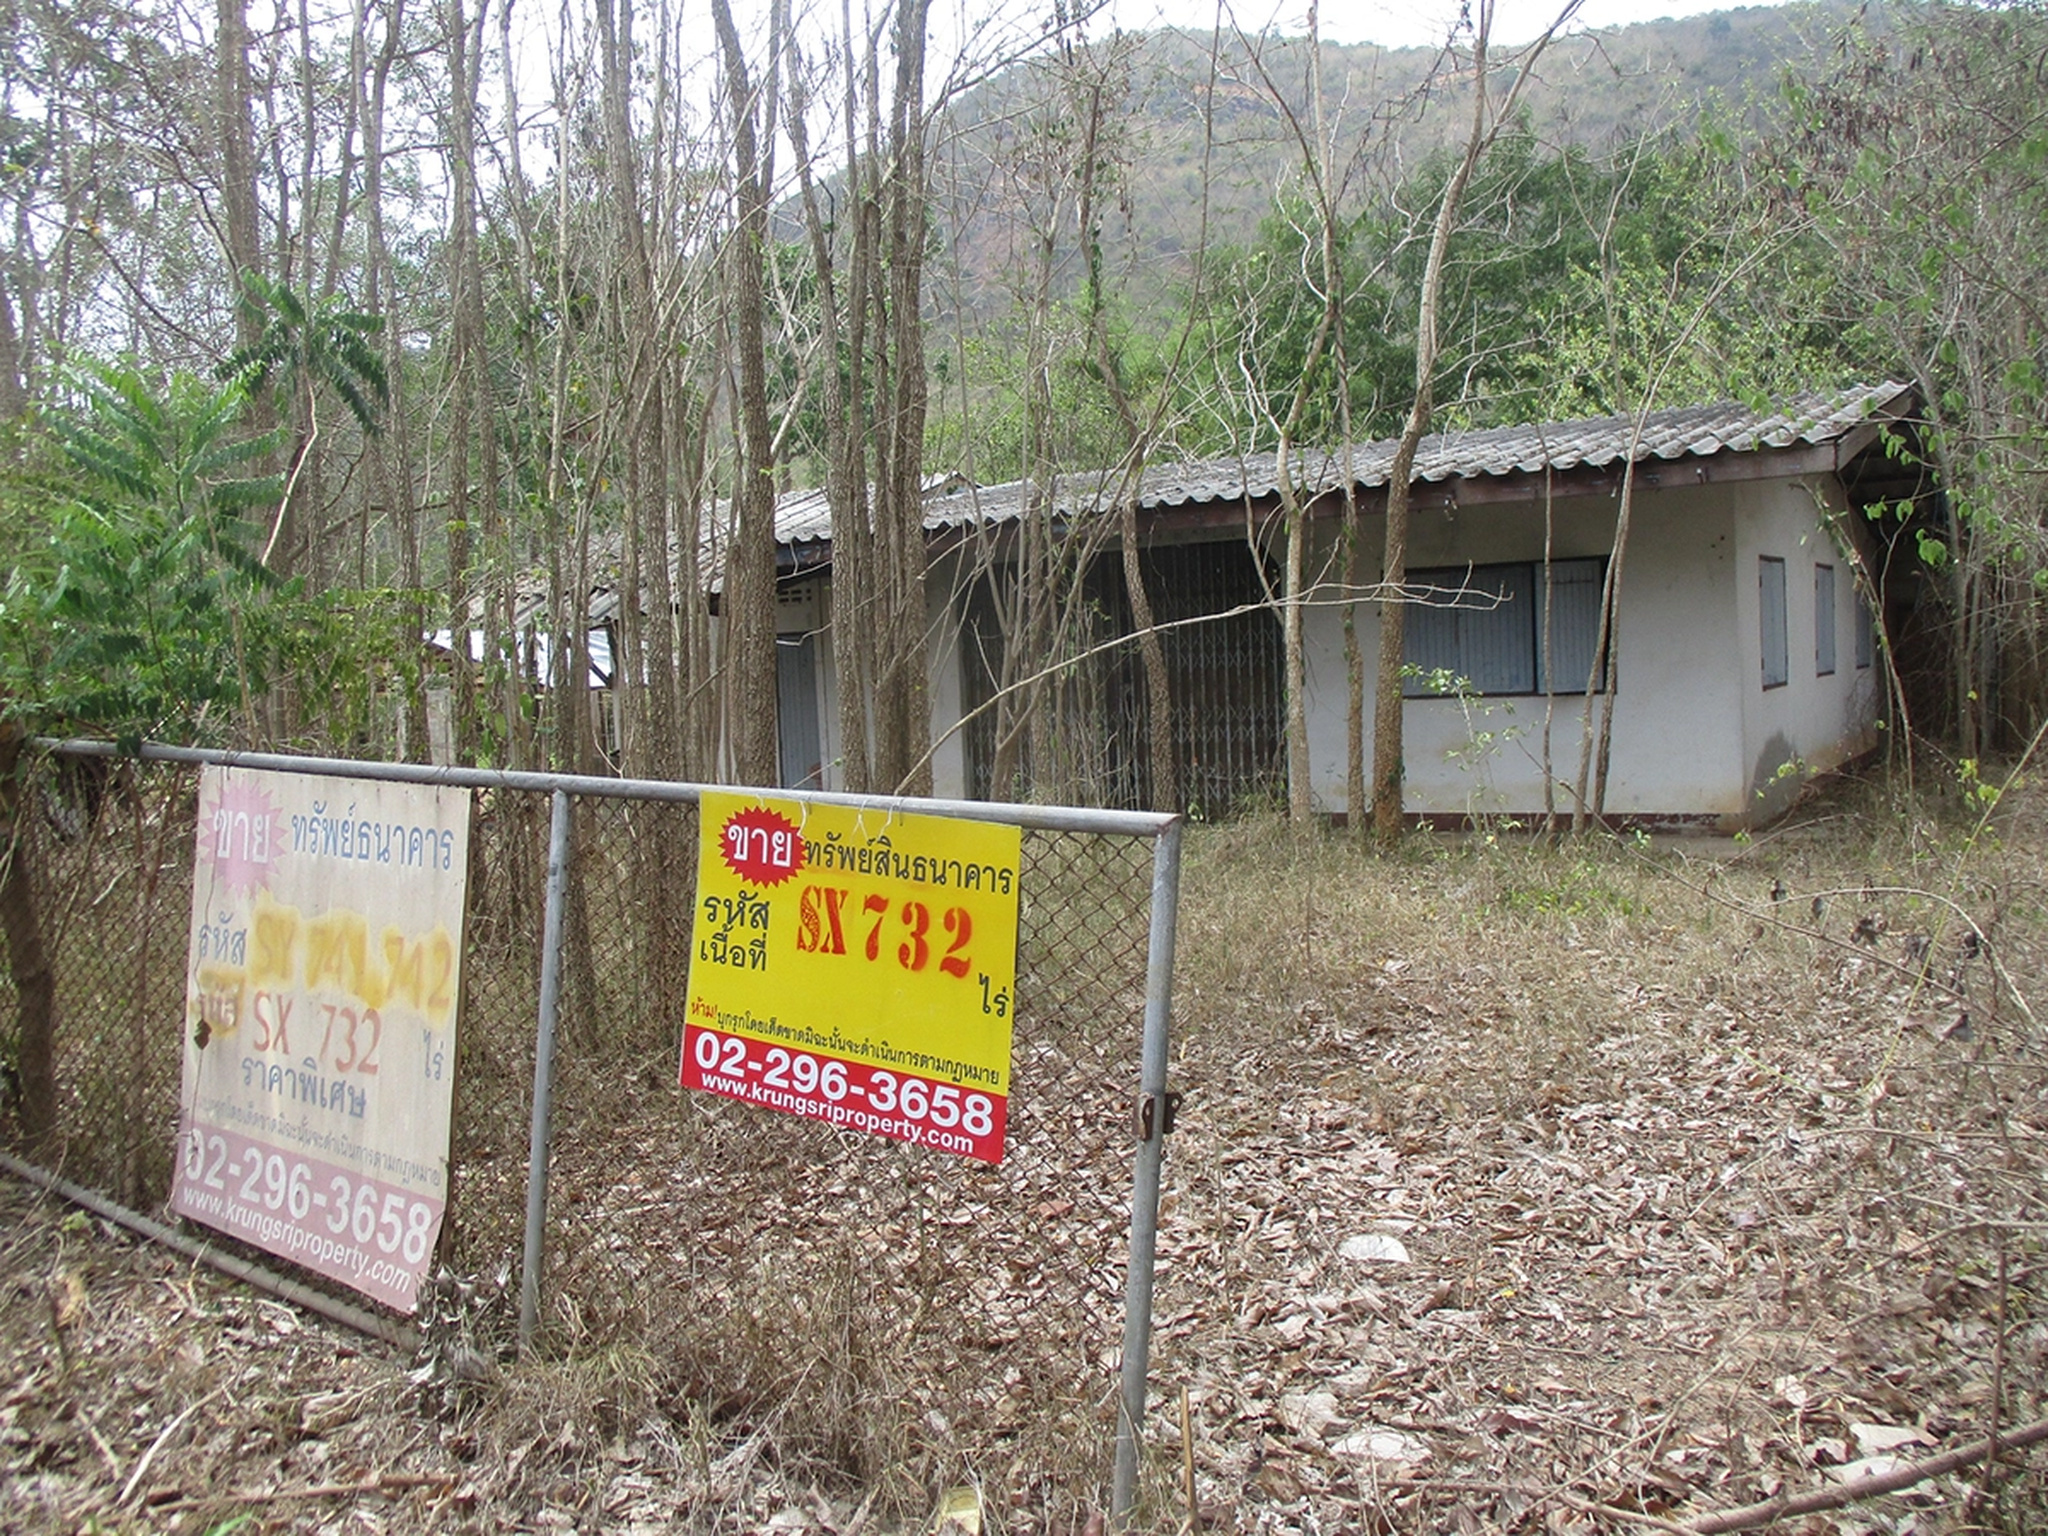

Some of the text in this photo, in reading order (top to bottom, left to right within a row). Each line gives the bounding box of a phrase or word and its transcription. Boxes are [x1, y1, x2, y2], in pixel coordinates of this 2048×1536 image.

[213, 808, 270, 864] ขาย
[291, 800, 454, 871] ทรัพย์ธนาคาร
[727, 823, 792, 868] ขาย
[804, 830, 1014, 895] ทรัพย์สินธนาคาร
[199, 910, 248, 967] รหัส
[703, 890, 771, 931] รหัส
[797, 884, 973, 980] SX 732
[700, 923, 768, 972] เนื้อที่
[978, 971, 1010, 1018] ไร่
[253, 989, 382, 1076] SX 732
[423, 1028, 445, 1081] ไร่
[242, 1056, 368, 1119] ราคาพิเศษ
[694, 1031, 993, 1137] 02-296-3658
[701, 1071, 974, 1153] www.krungsriproperty.com
[185, 1128, 432, 1265] 02-296-3658
[183, 1185, 411, 1293] www.krungsriproperty.com
